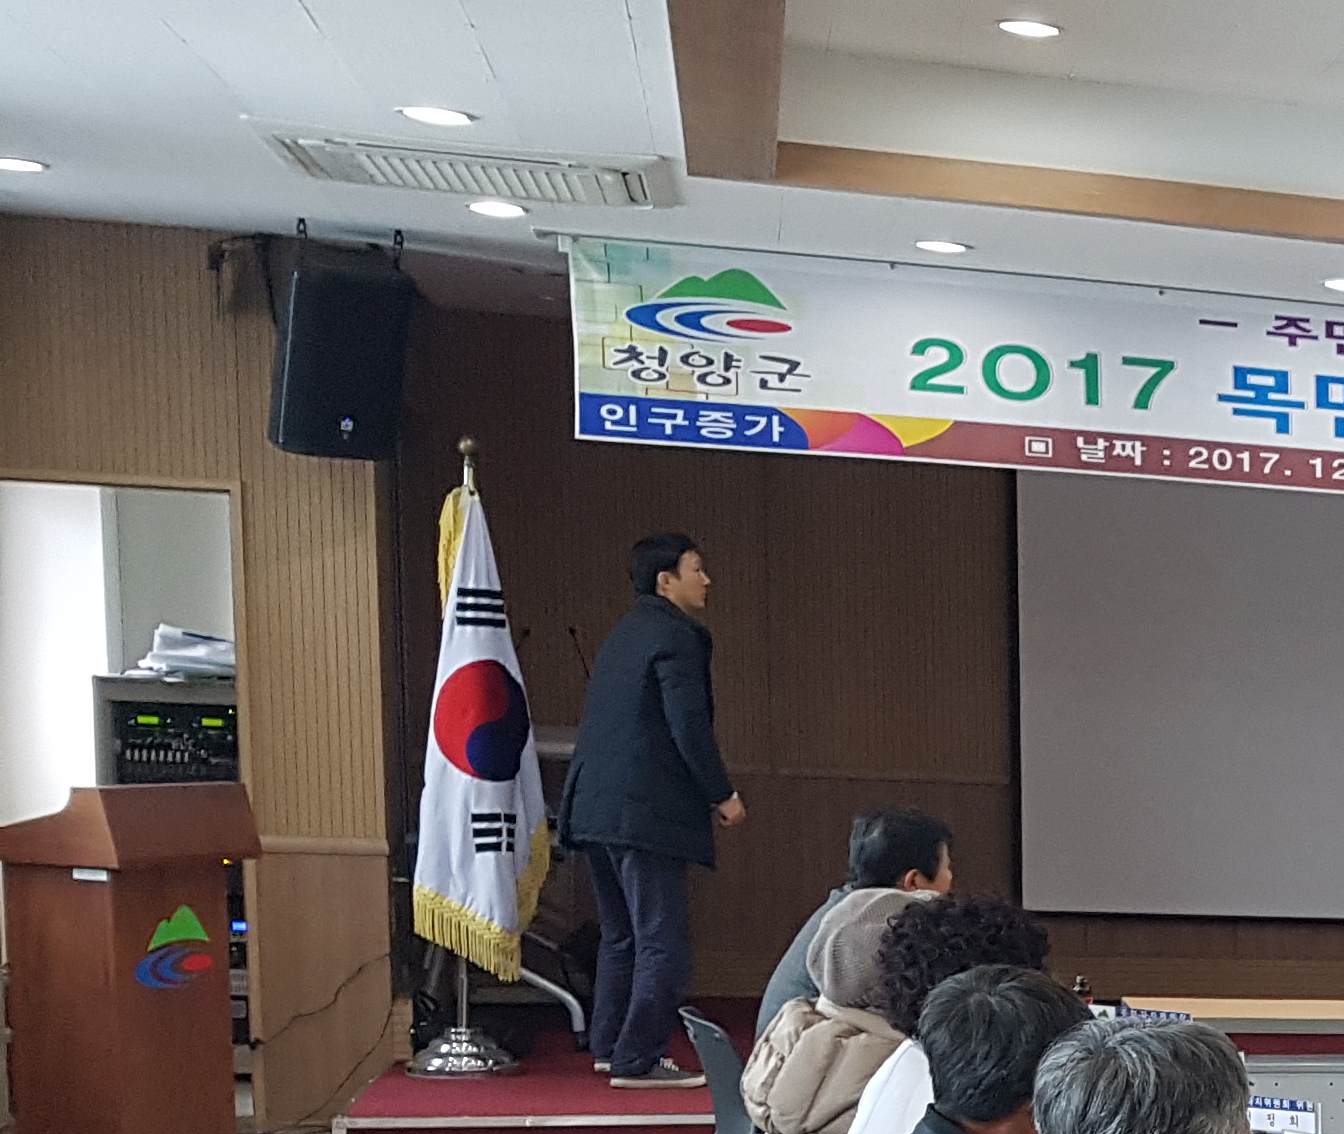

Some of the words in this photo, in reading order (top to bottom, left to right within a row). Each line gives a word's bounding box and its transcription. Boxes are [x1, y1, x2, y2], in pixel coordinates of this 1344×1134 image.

[612, 343, 812, 394] 청양군
[909, 337, 1176, 410] 2017
[600, 402, 786, 443] 인구증가
[1076, 435, 1147, 466] 날짜
[1188, 445, 1292, 477] 2017.
